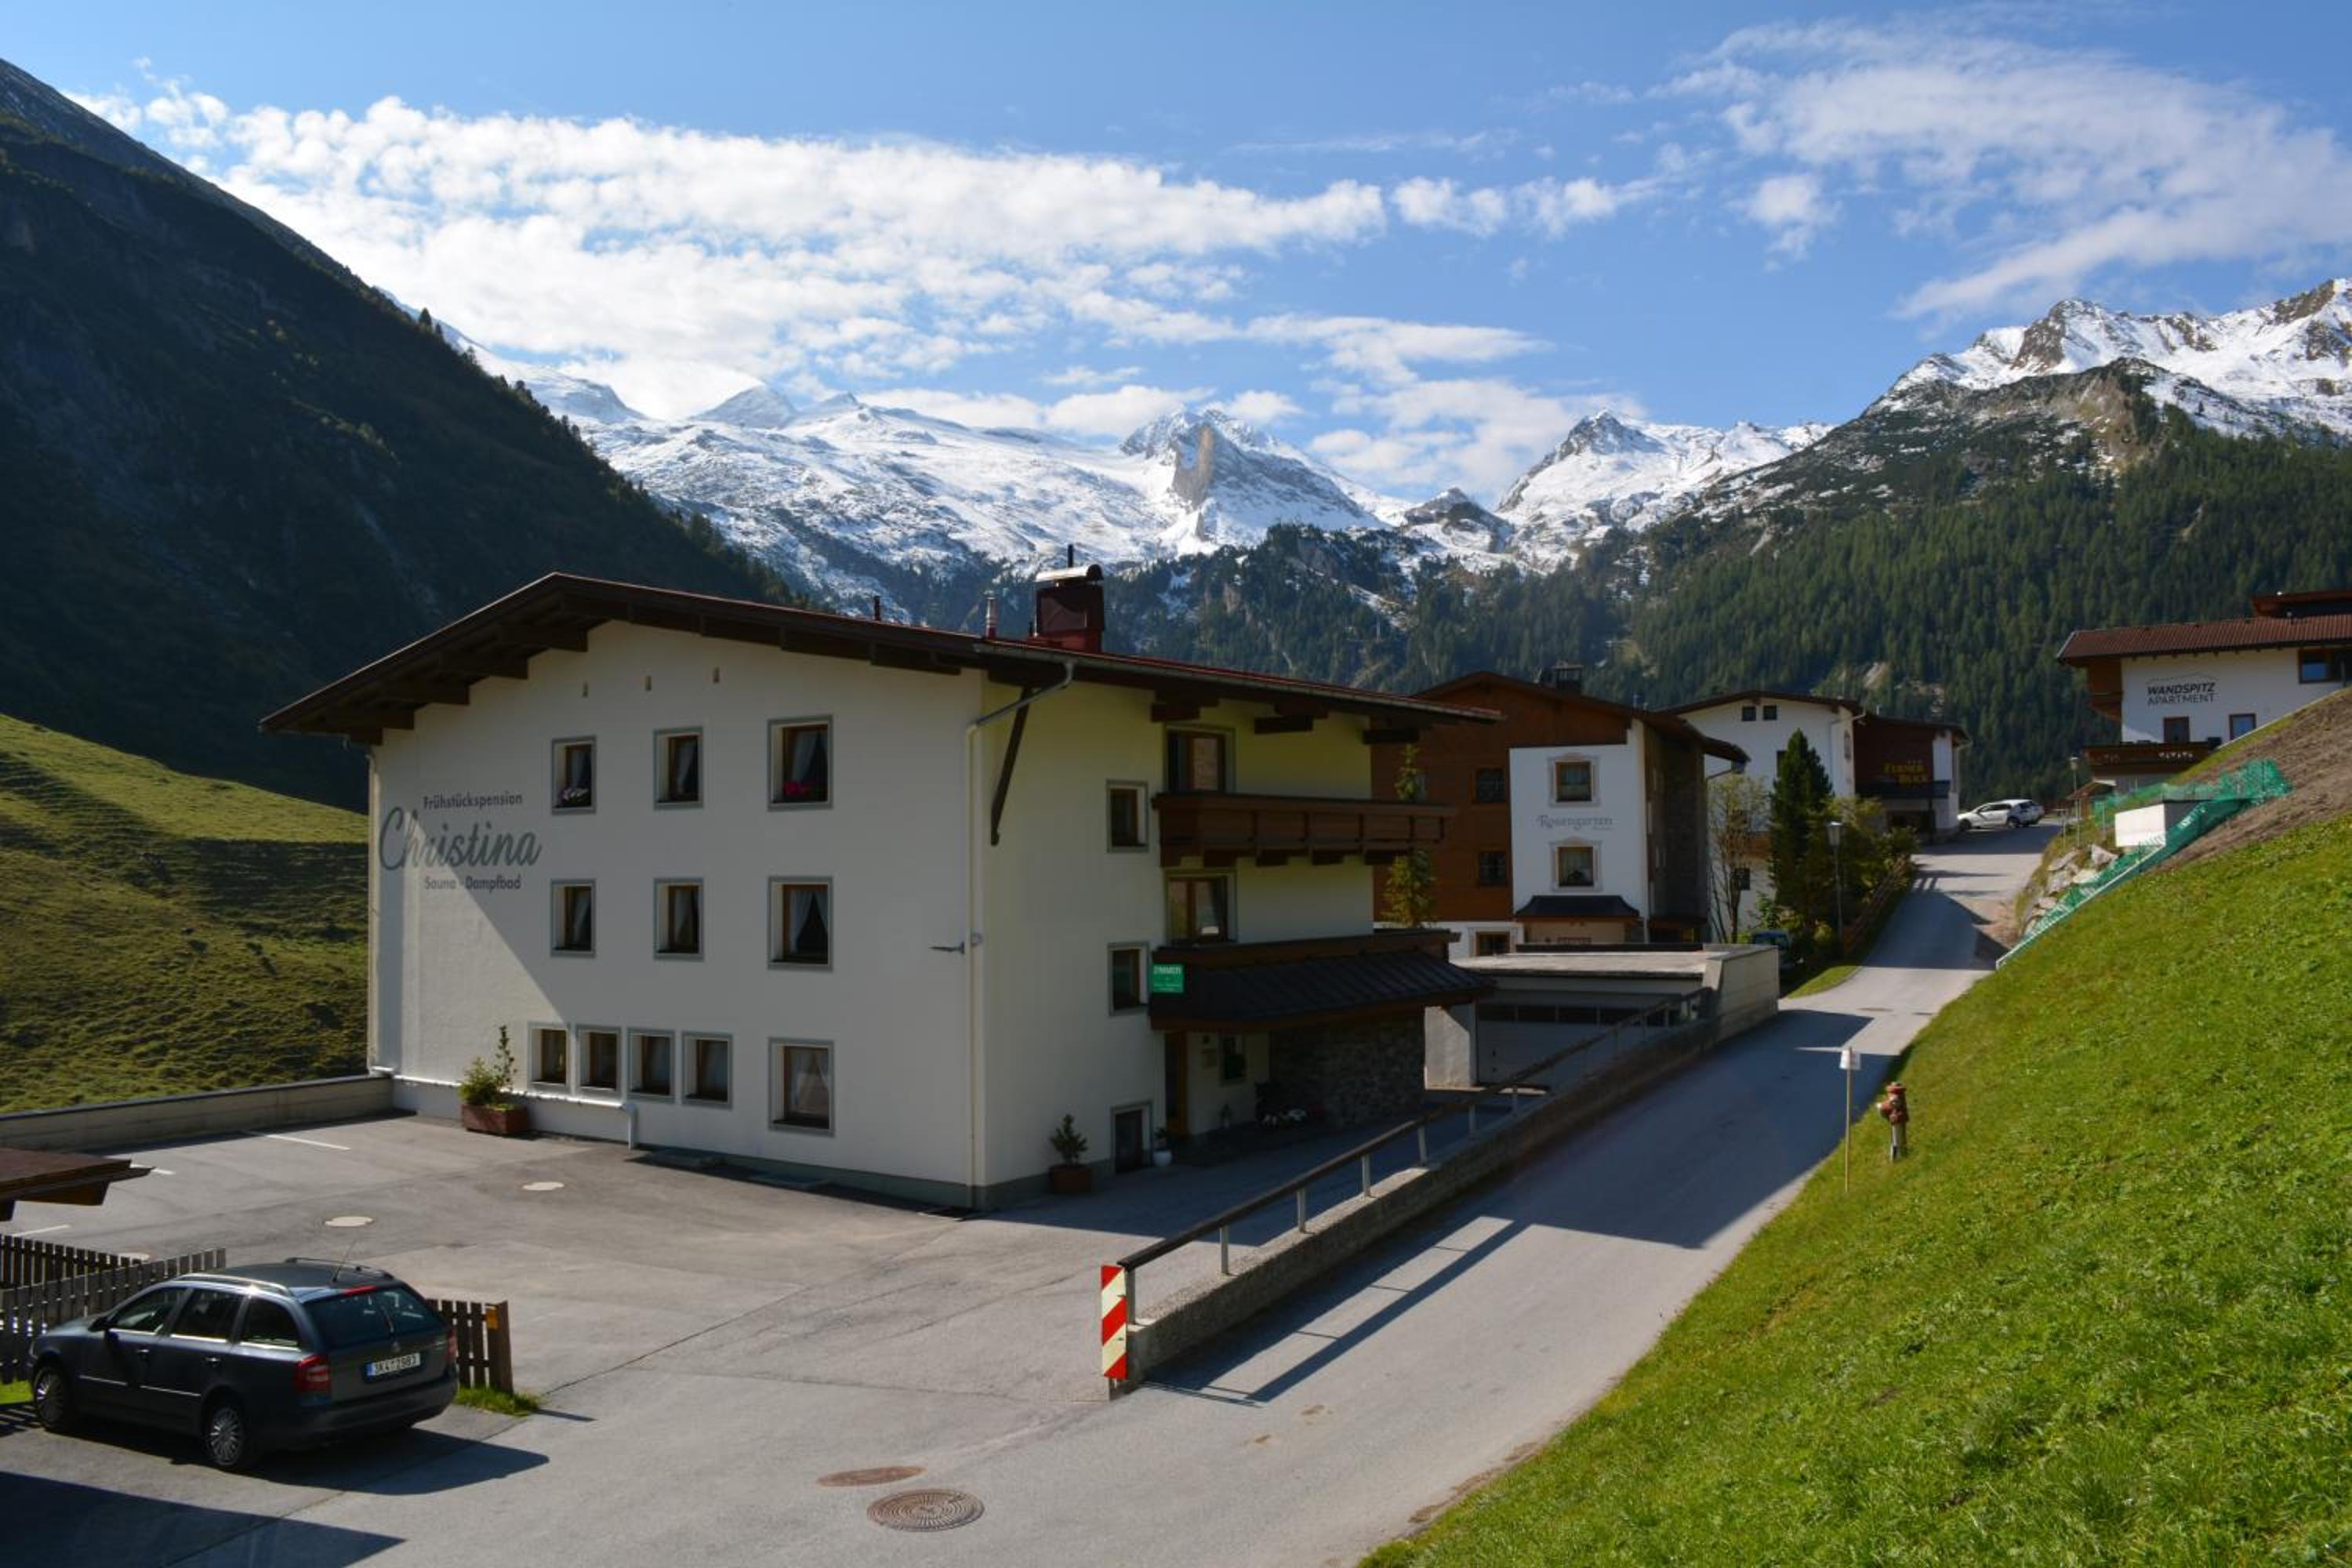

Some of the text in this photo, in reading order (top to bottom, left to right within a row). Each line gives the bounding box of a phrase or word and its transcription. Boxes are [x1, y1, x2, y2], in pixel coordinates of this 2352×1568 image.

[2147, 682, 2216, 695] WANDSPITZ
[2147, 693, 2215, 704] APARTMENT
[423, 792, 523, 810] Frühstückspension
[379, 806, 543, 871] Christina
[424, 877, 456, 890] Sauna
[464, 874, 522, 893] Dampfbad
